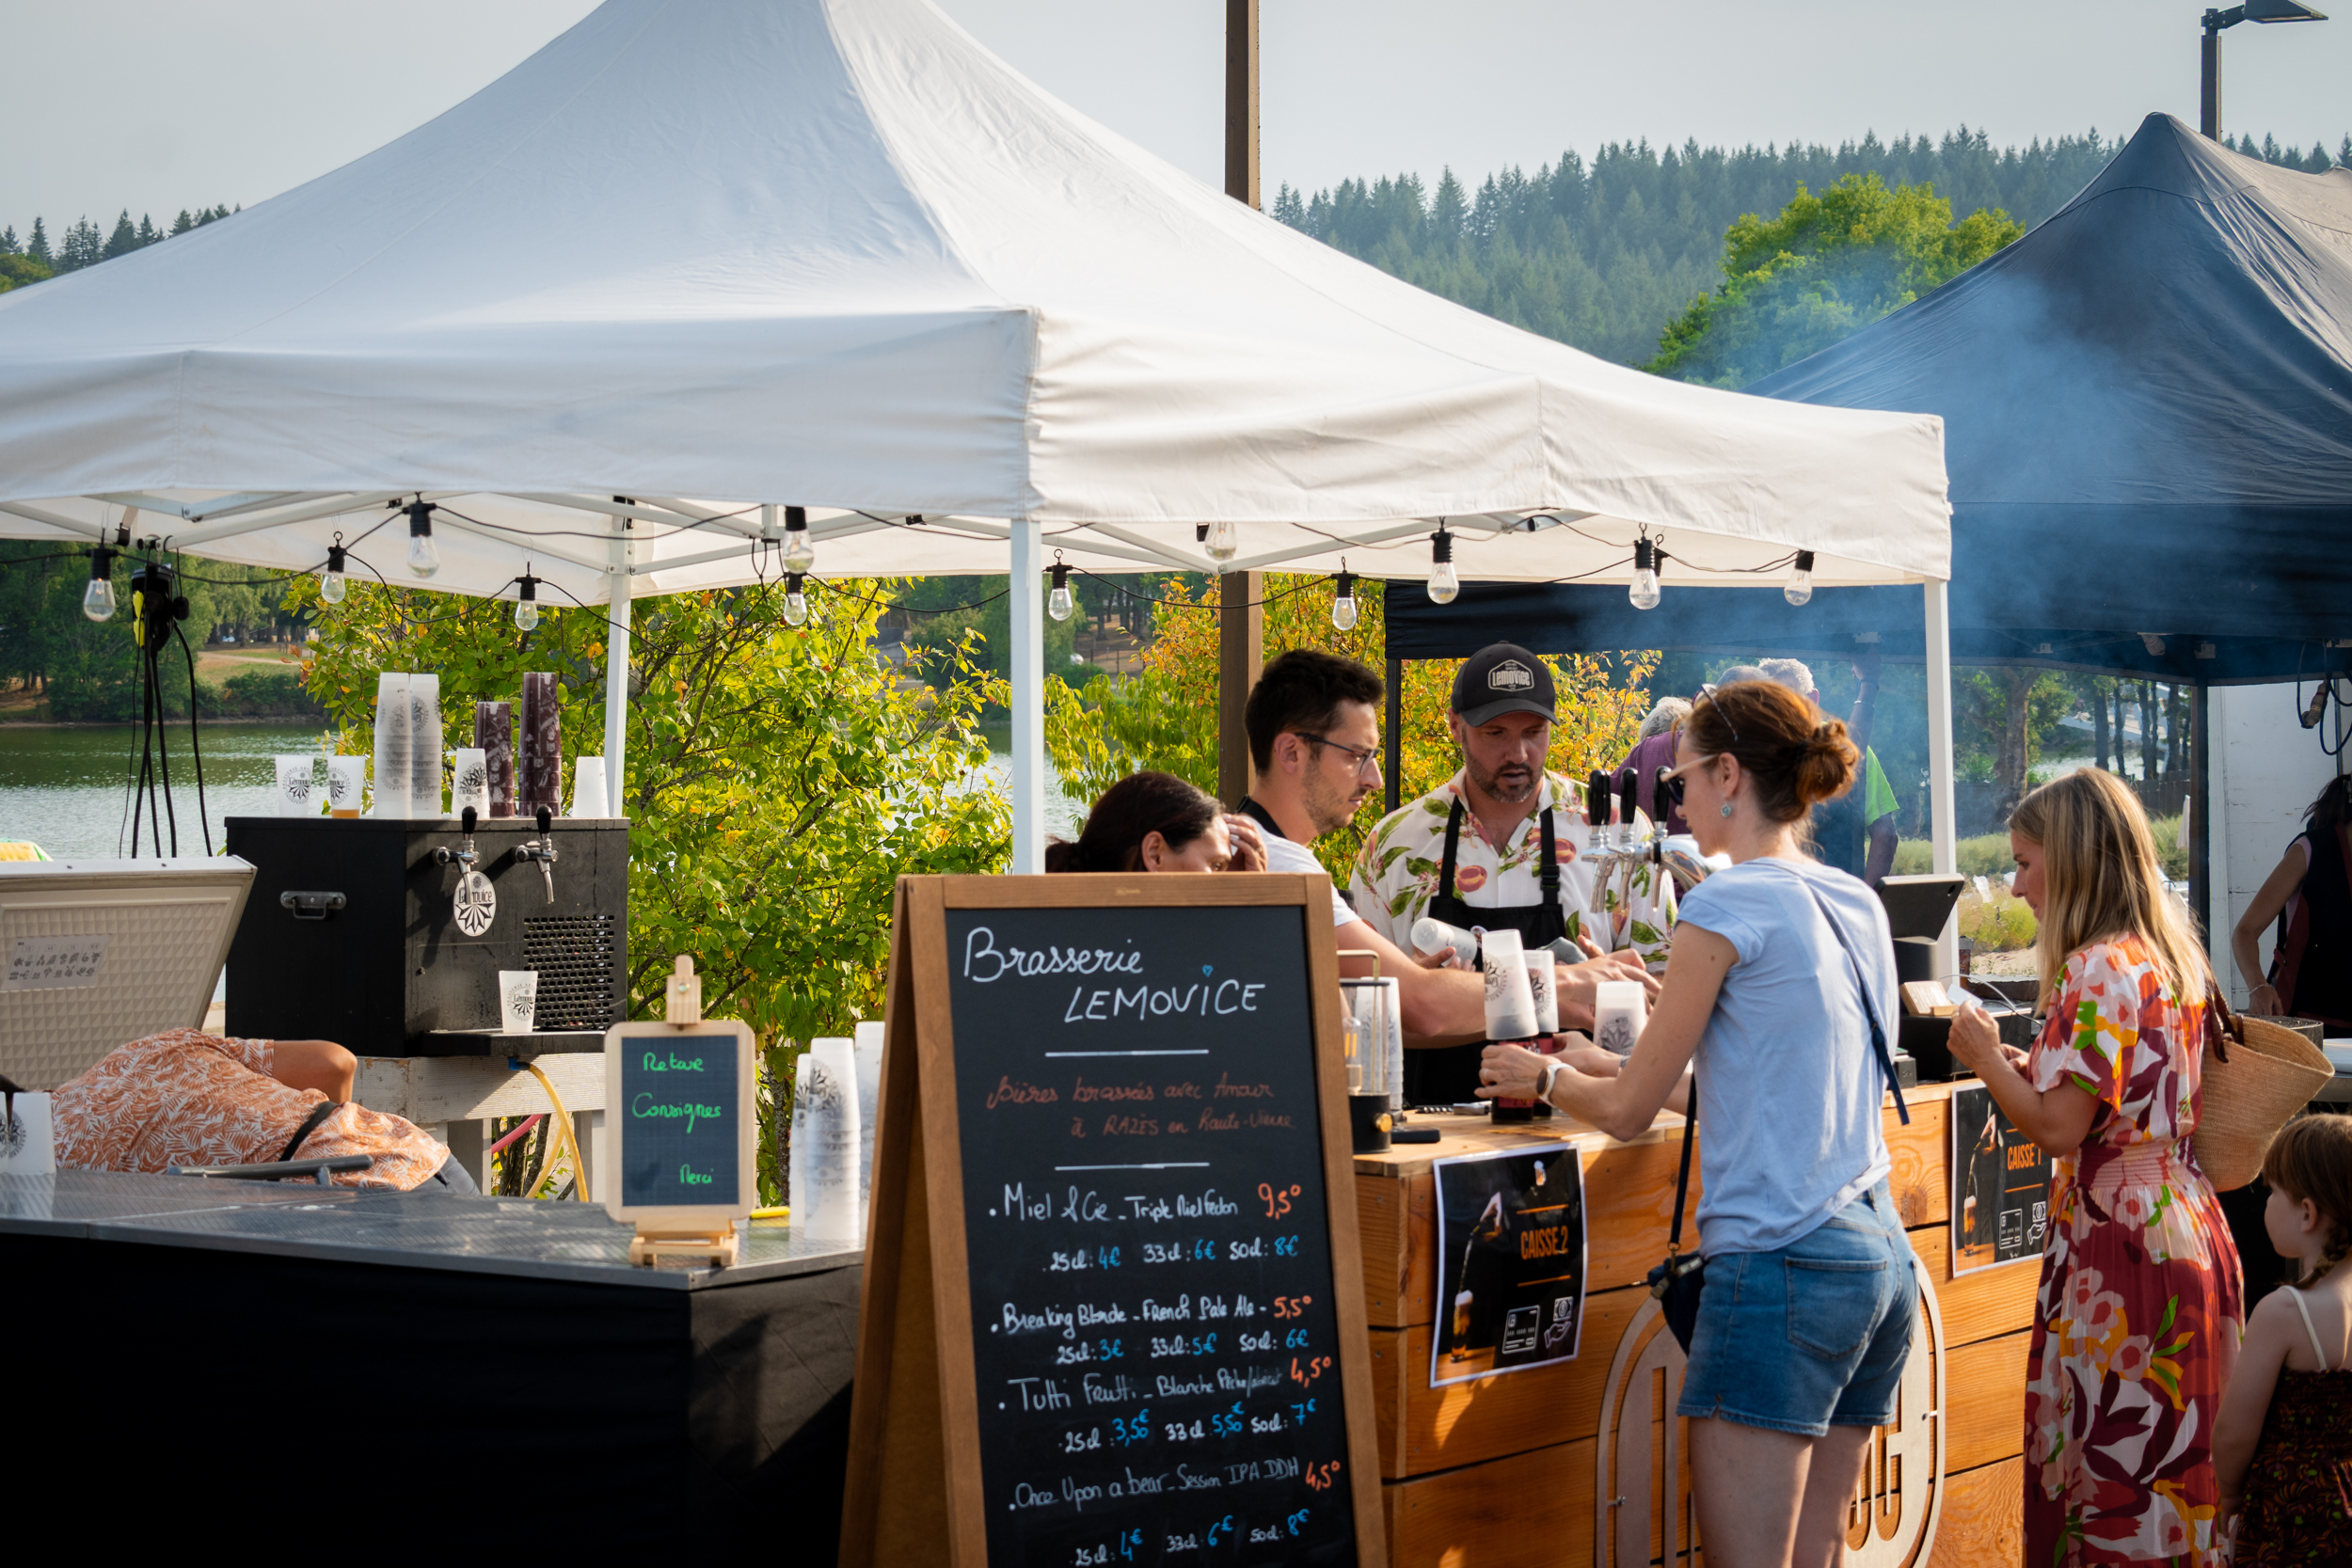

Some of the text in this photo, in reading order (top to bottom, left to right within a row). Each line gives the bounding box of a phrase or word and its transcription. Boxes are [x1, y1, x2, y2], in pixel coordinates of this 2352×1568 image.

[964, 927, 1143, 982] Brasserie
[1064, 973, 1265, 1023] LEMOVICE
[632, 1093, 721, 1133] Consignes
[2007, 1143, 2035, 1171] CAISSE
[1005, 1182, 1051, 1220] Miel
[1099, 1246, 1120, 1270] 4€
[1195, 1239, 1216, 1259] 6€
[1274, 1235, 1298, 1257] 8€
[1520, 1225, 1568, 1259] CAISSE 2
[1100, 1338, 1123, 1361] 3€
[1192, 1333, 1216, 1354] 5€
[1286, 1329, 1309, 1349] 6€
[1291, 1398, 1315, 1425] 7€
[1062, 1476, 1102, 1512] Upon
[1109, 1482, 1123, 1497] a
[1120, 1528, 1142, 1560] 4€
[1208, 1514, 1232, 1546] 6€
[1287, 1509, 1310, 1536] 8€
